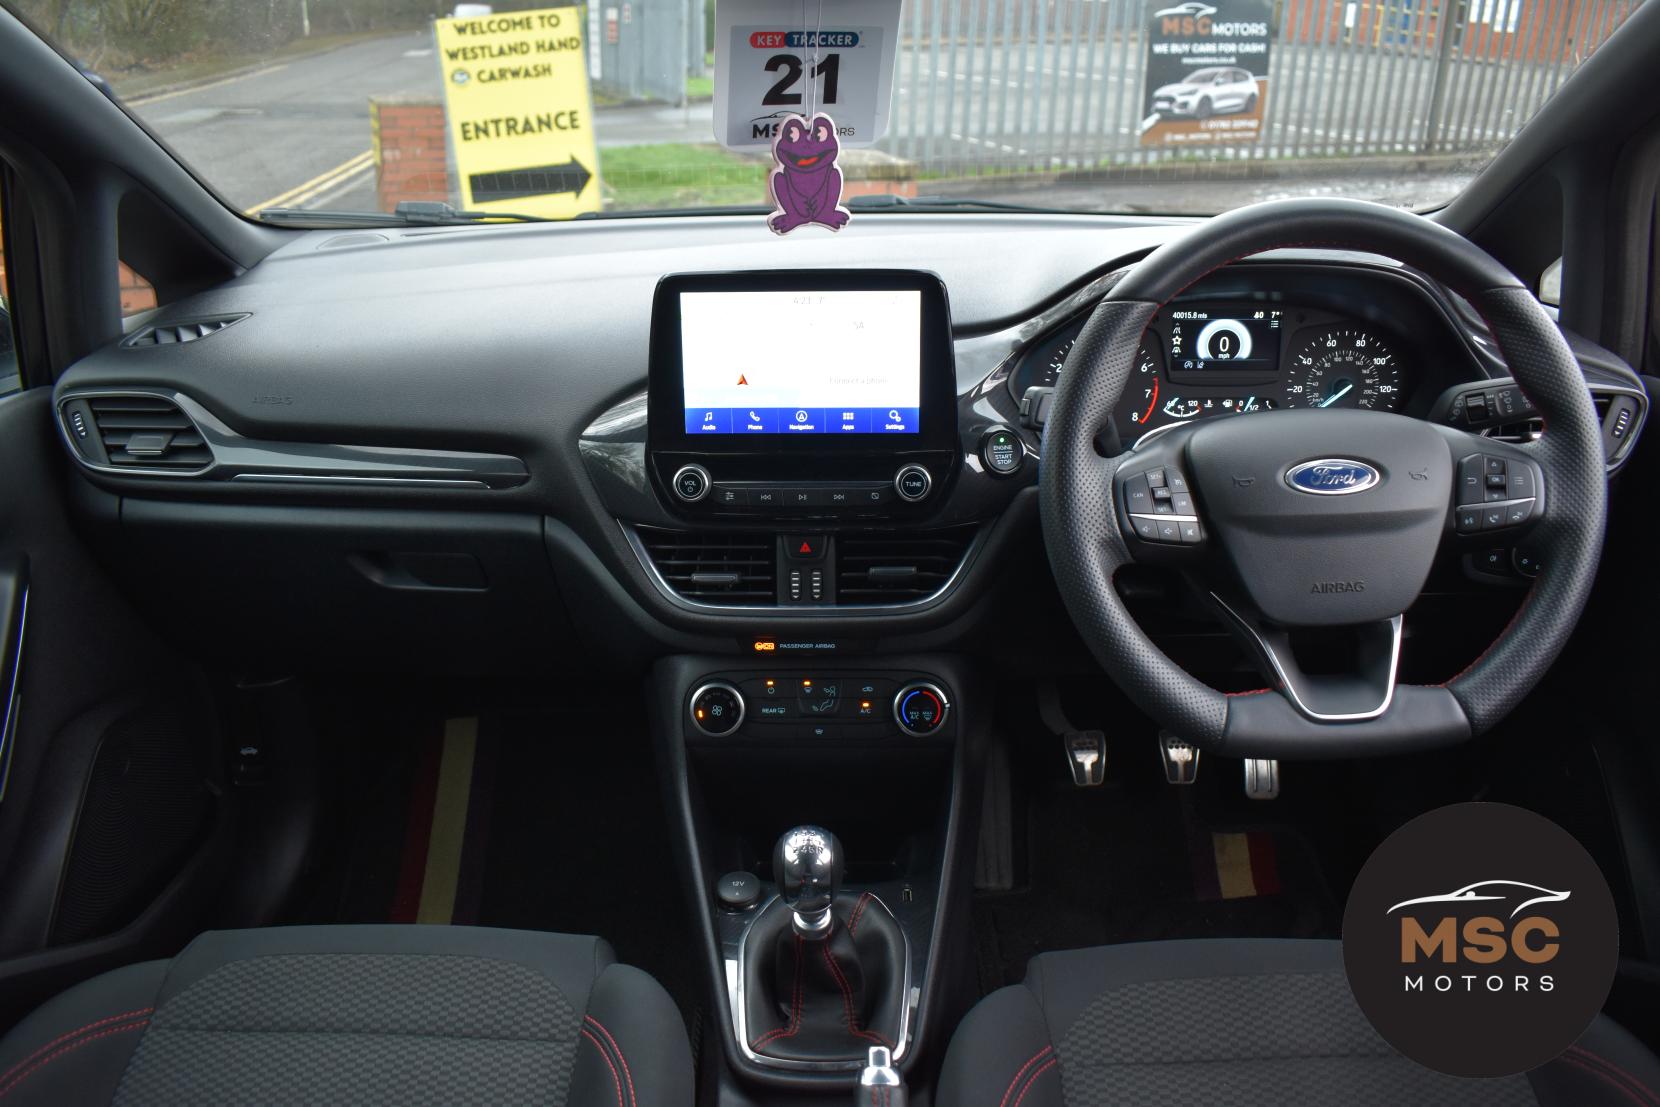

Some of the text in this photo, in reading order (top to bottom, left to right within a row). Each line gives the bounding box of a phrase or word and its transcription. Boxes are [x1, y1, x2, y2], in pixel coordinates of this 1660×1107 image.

[453, 14, 560, 36] WELCOME TO
[1162, 16, 1268, 36] MSC MOTORS
[757, 34, 852, 46] KEY TRACKER
[446, 37, 581, 61] WESTLAND HAND
[1153, 43, 1168, 54] WE
[1170, 43, 1190, 54] BUY
[1191, 43, 1217, 54] CARS
[1218, 43, 1237, 53] FOR
[477, 65, 552, 83] CARWASH
[761, 53, 840, 106] 21
[460, 110, 580, 141] ENTRANCE
[1172, 311, 1197, 319] 40015.8
[1220, 337, 1229, 352] 0
[1056, 364, 1062, 372] 2
[1141, 364, 1147, 372] 6
[1145, 389, 1151, 398] 7
[1132, 413, 1138, 421] 8
[885, 424, 905, 432] Settings
[1310, 466, 1356, 486] Ford
[1311, 581, 1365, 594] AIRBAG
